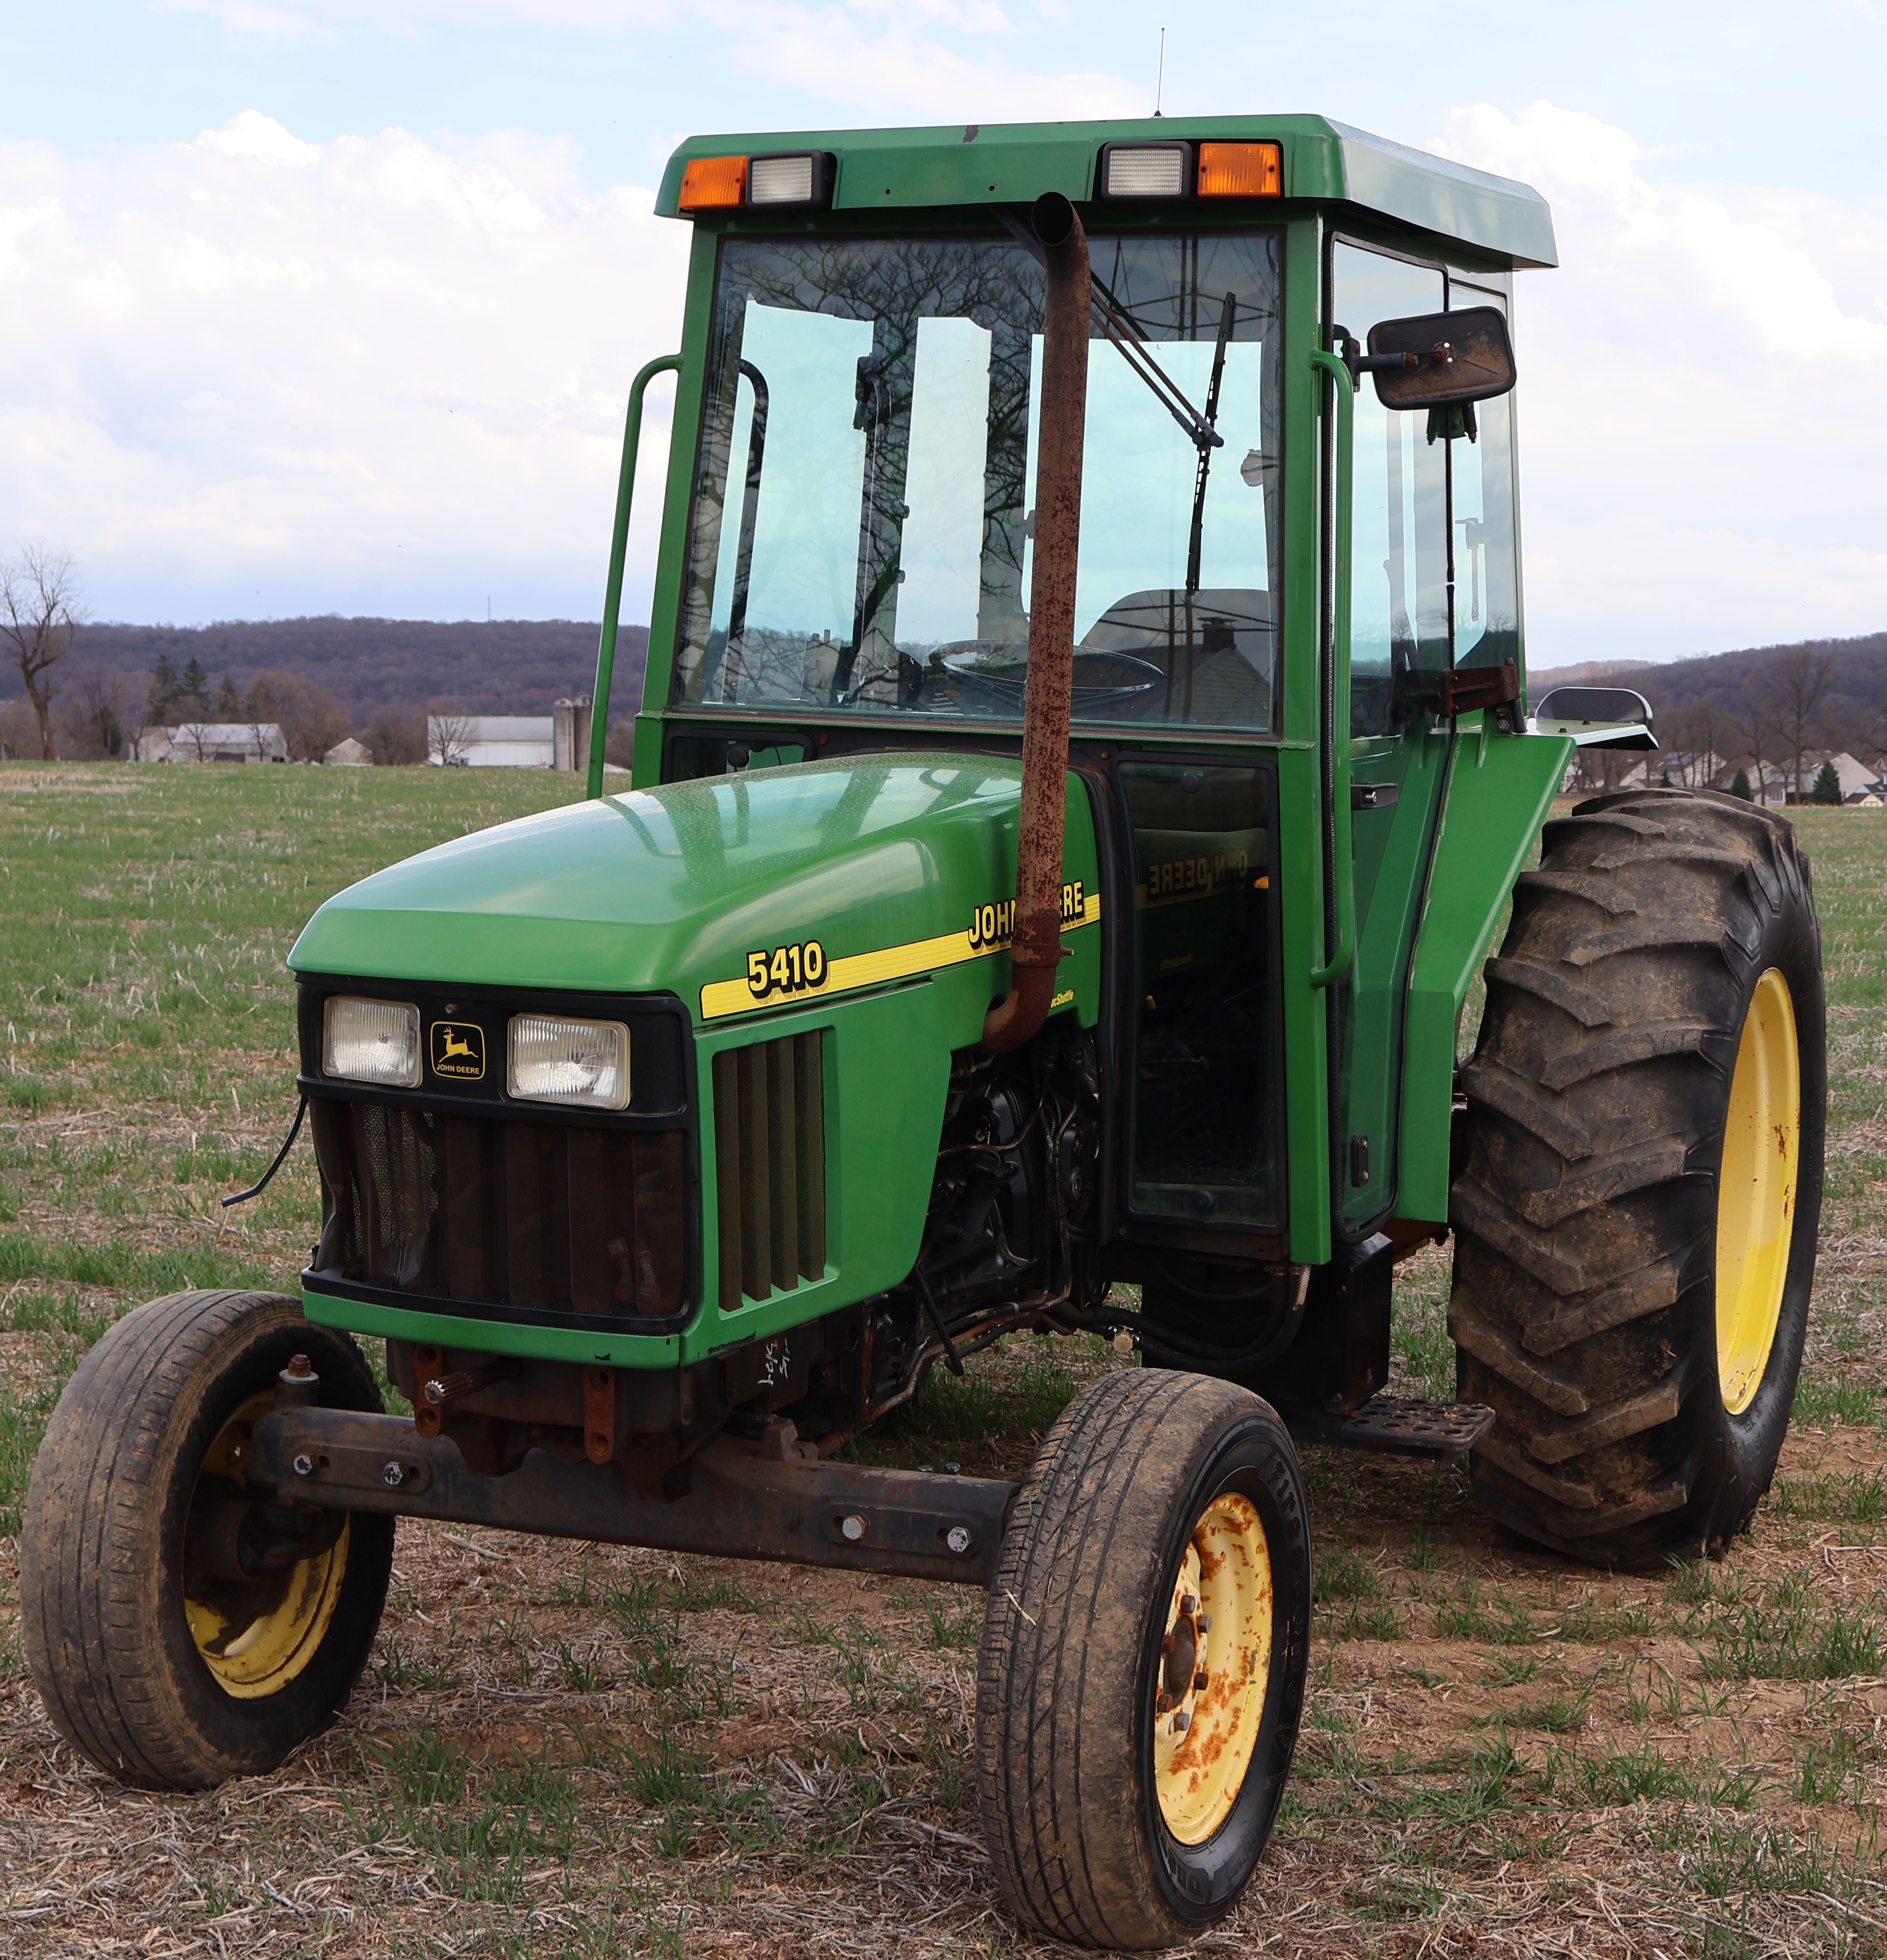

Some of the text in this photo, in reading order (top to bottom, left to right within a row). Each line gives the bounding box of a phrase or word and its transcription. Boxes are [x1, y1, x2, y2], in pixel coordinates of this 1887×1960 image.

[747, 940, 825, 996] 5410
[1049, 989, 1074, 1010] ncShuttle
[436, 1063, 480, 1075] JOHN DEERE
